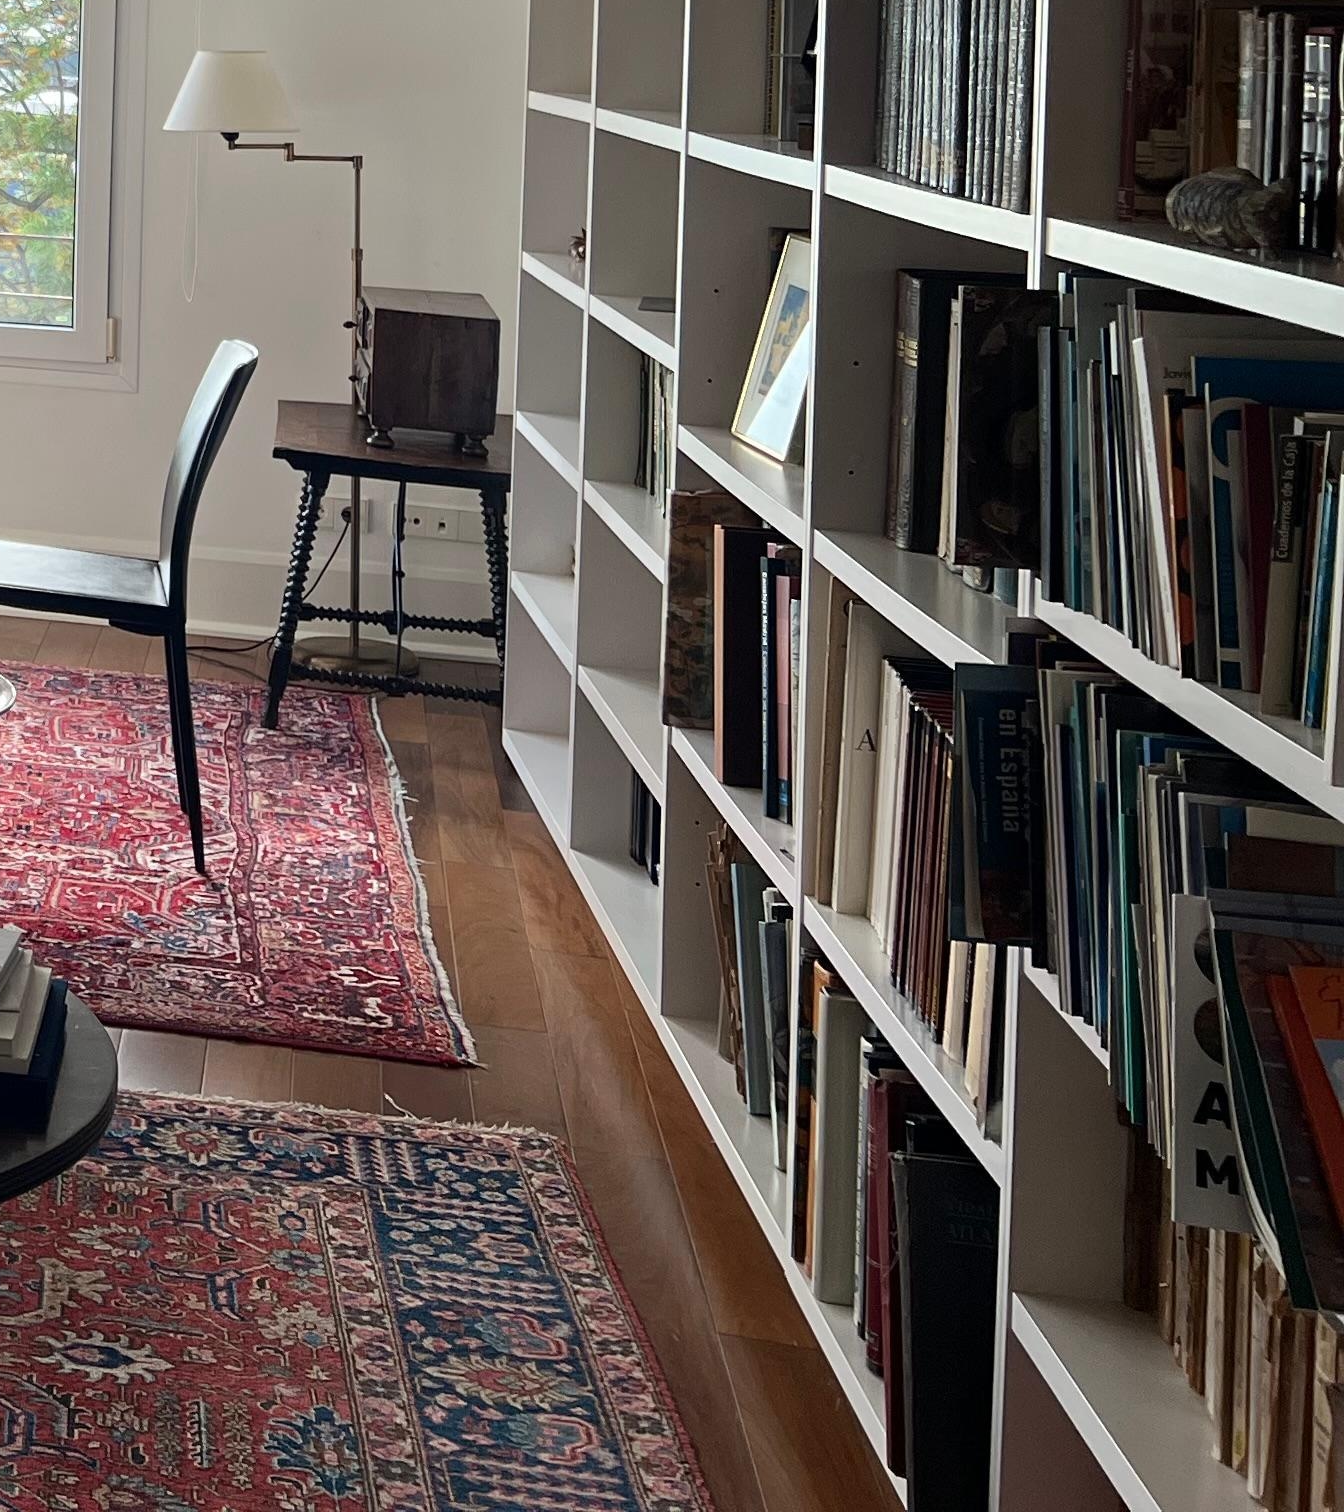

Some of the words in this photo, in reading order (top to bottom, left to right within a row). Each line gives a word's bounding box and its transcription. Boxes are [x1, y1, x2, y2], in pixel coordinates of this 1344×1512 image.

[1282, 483, 1293, 497] de
[1275, 499, 1293, 559] Cuadernos
[998, 708, 1017, 736] en
[855, 728, 878, 752] A
[995, 747, 1023, 833] España
